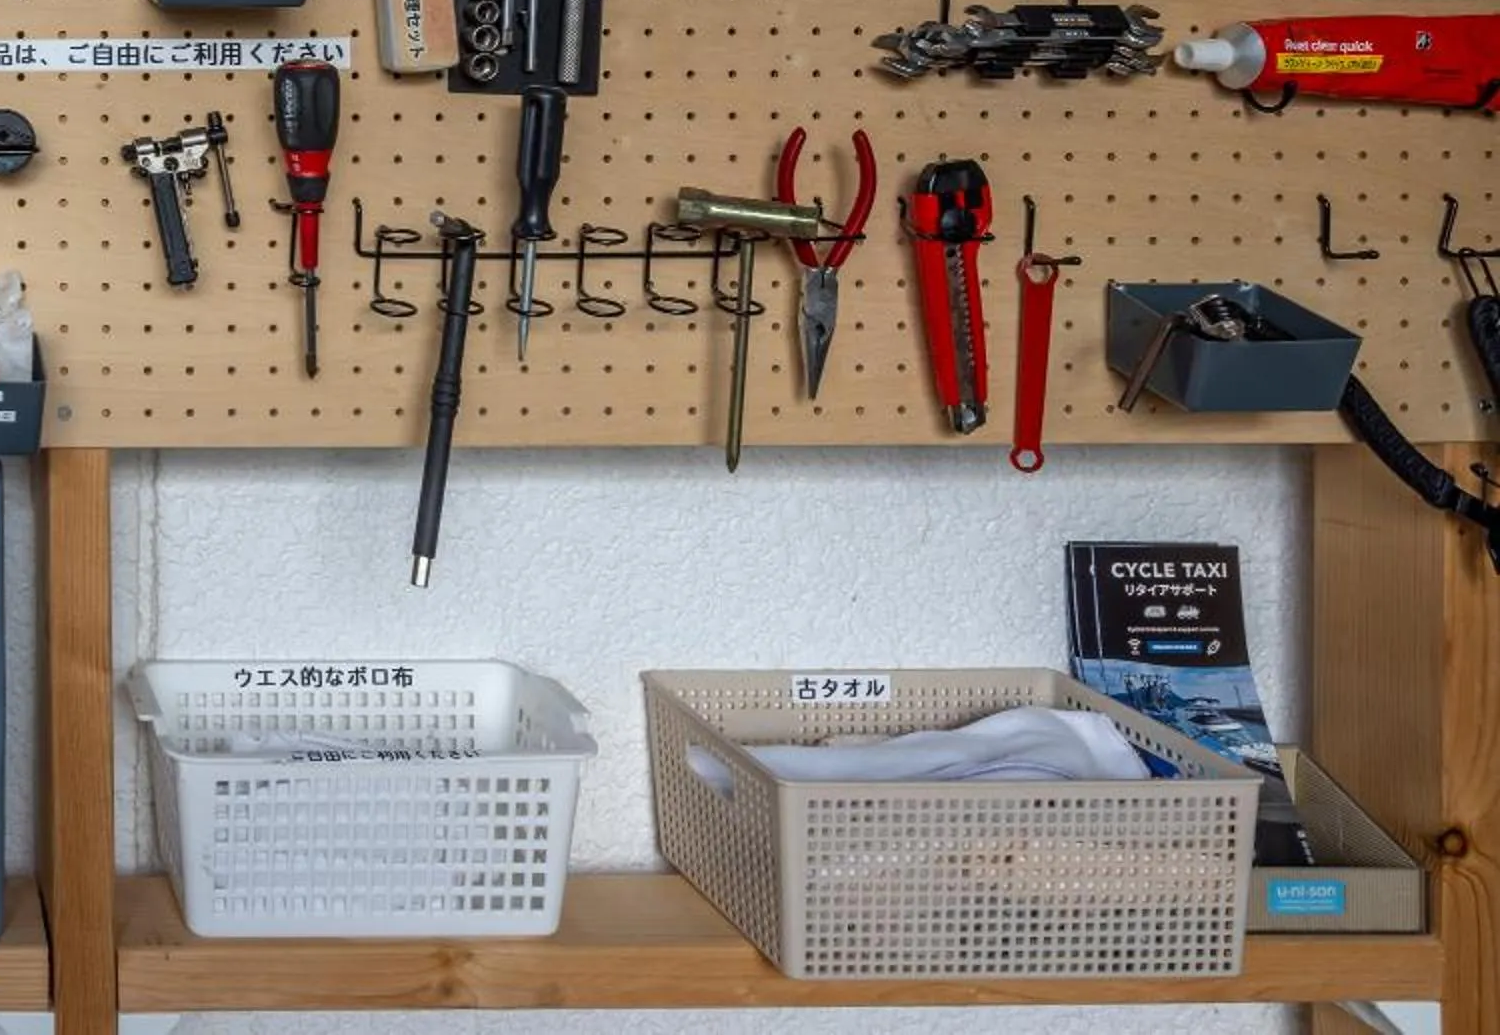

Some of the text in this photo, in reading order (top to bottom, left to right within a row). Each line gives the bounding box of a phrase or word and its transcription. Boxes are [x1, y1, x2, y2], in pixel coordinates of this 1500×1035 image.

[1111, 562, 1228, 578] CYCLE TAXI
[1124, 584, 1217, 597] リタイアサポート
[234, 666, 415, 689] ウエス的なボロ布
[795, 677, 885, 700] 古タオル
